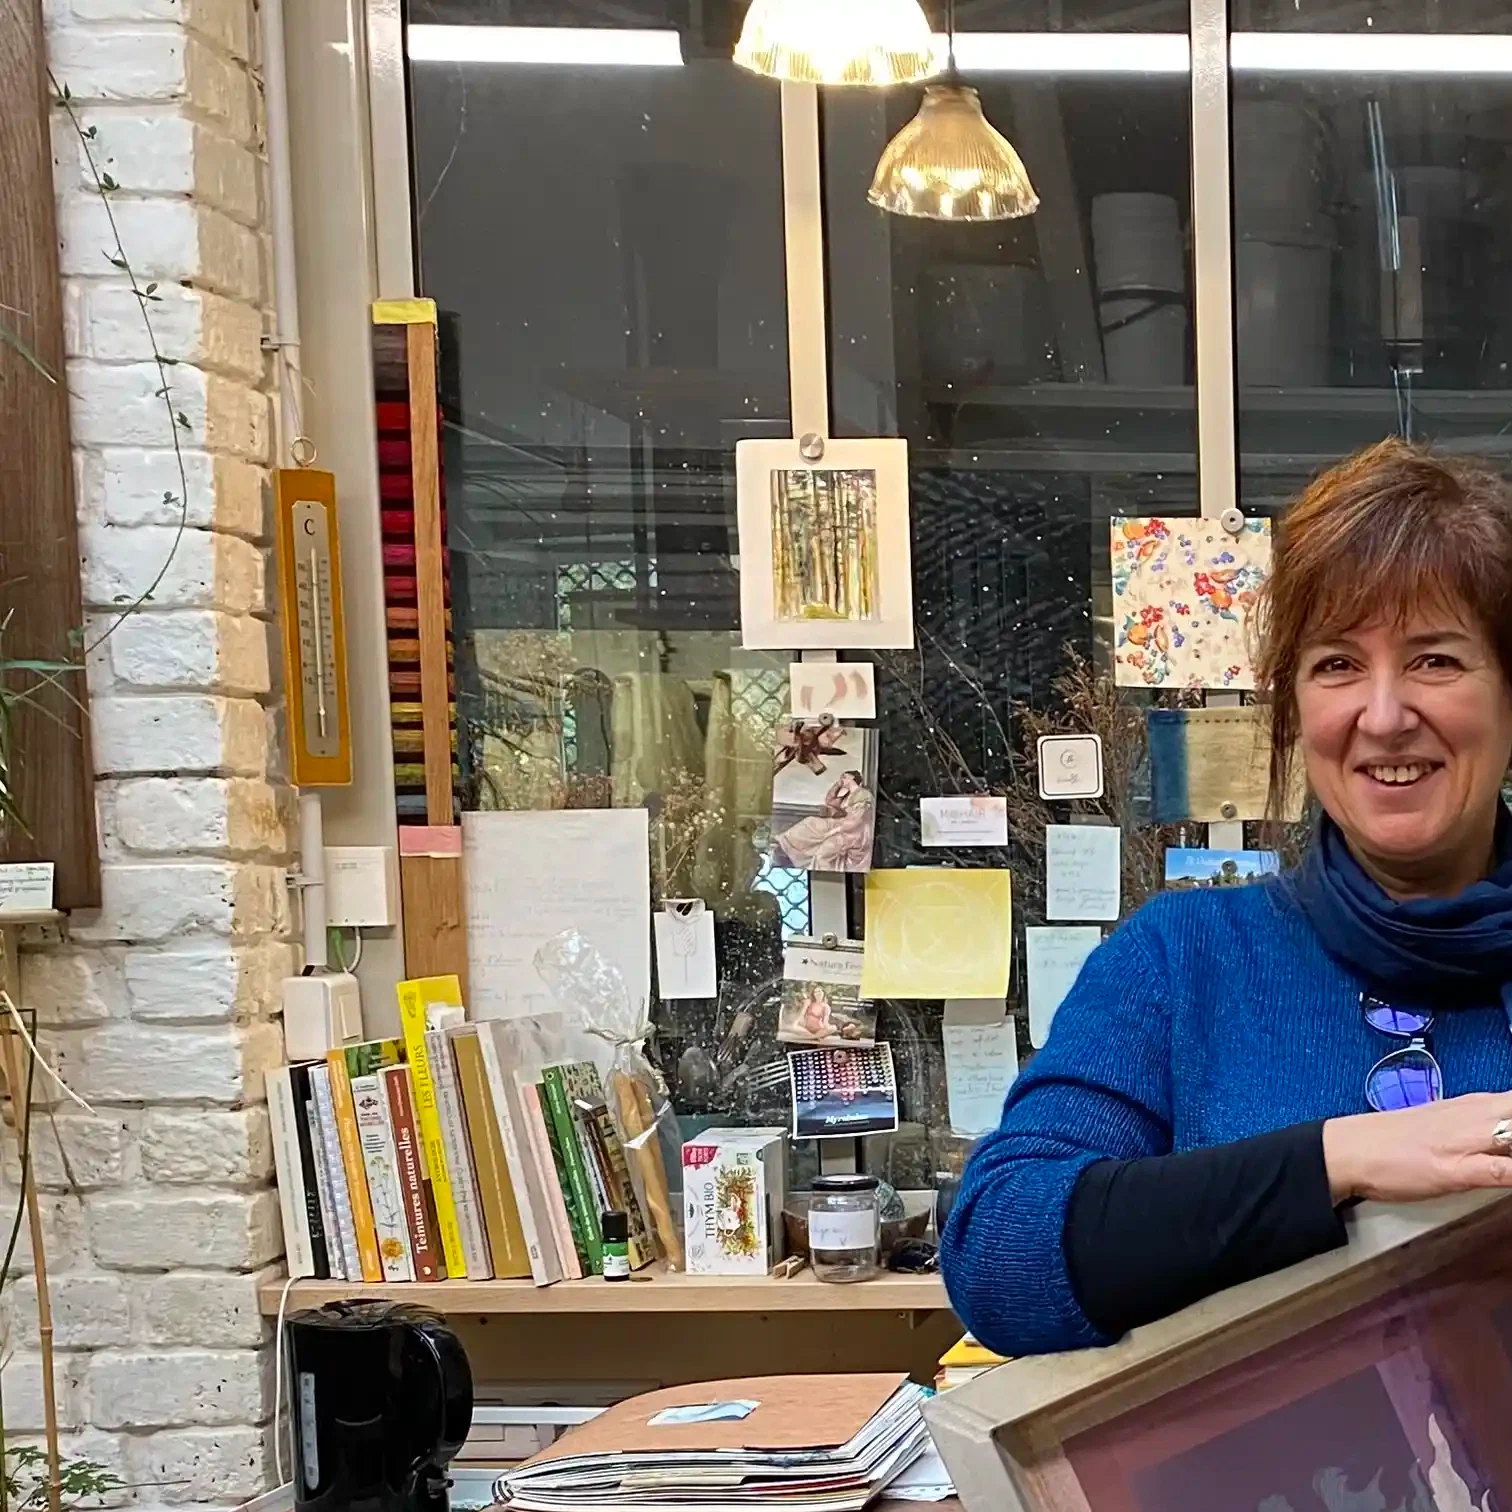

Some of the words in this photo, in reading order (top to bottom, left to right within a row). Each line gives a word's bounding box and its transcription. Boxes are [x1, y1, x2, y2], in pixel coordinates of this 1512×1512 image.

[304, 518, 316, 536] C
[421, 1089, 433, 1109] LES
[398, 1127, 417, 1189] naturelles
[703, 1182, 714, 1201] BIO
[410, 1191, 429, 1254] Teintures
[705, 1204, 715, 1239] THYM
